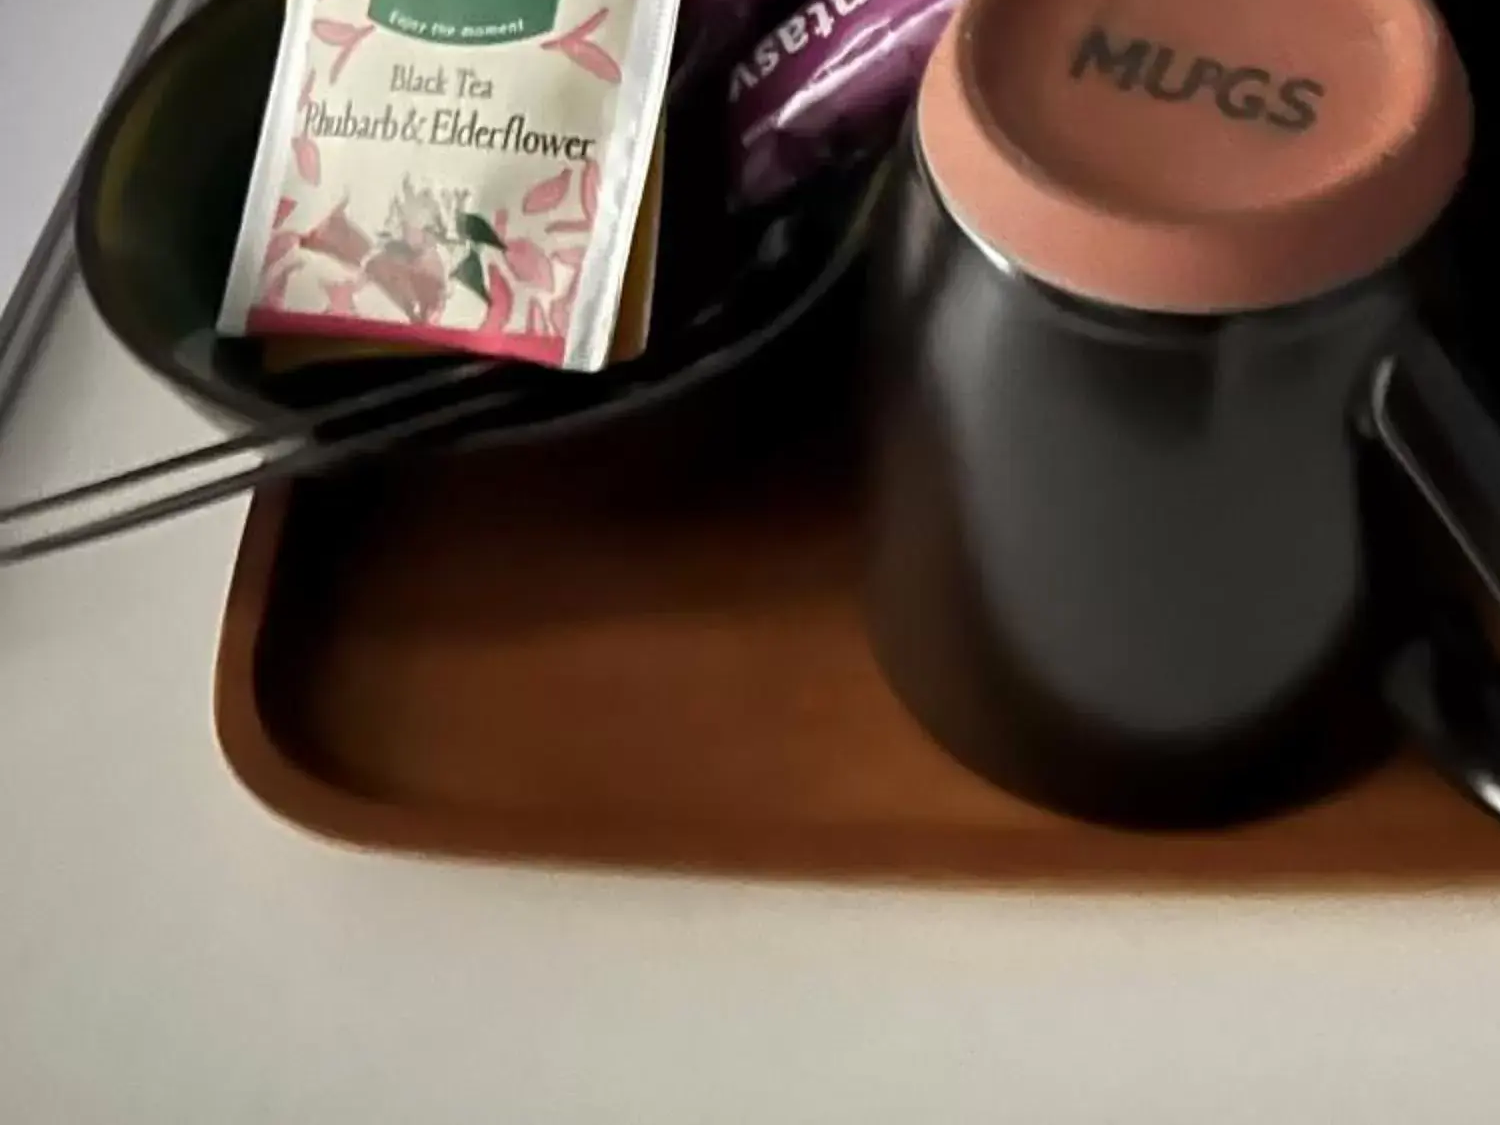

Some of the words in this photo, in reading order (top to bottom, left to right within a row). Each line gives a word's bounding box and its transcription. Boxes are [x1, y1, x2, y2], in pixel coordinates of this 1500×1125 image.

[461, 18, 525, 38] moment
[390, 63, 449, 96] Black
[456, 67, 494, 99] Tea
[1069, 29, 1325, 131] MUGS
[302, 100, 398, 142] Rhubarb
[401, 105, 426, 144] &
[431, 108, 597, 161] Elderflower
